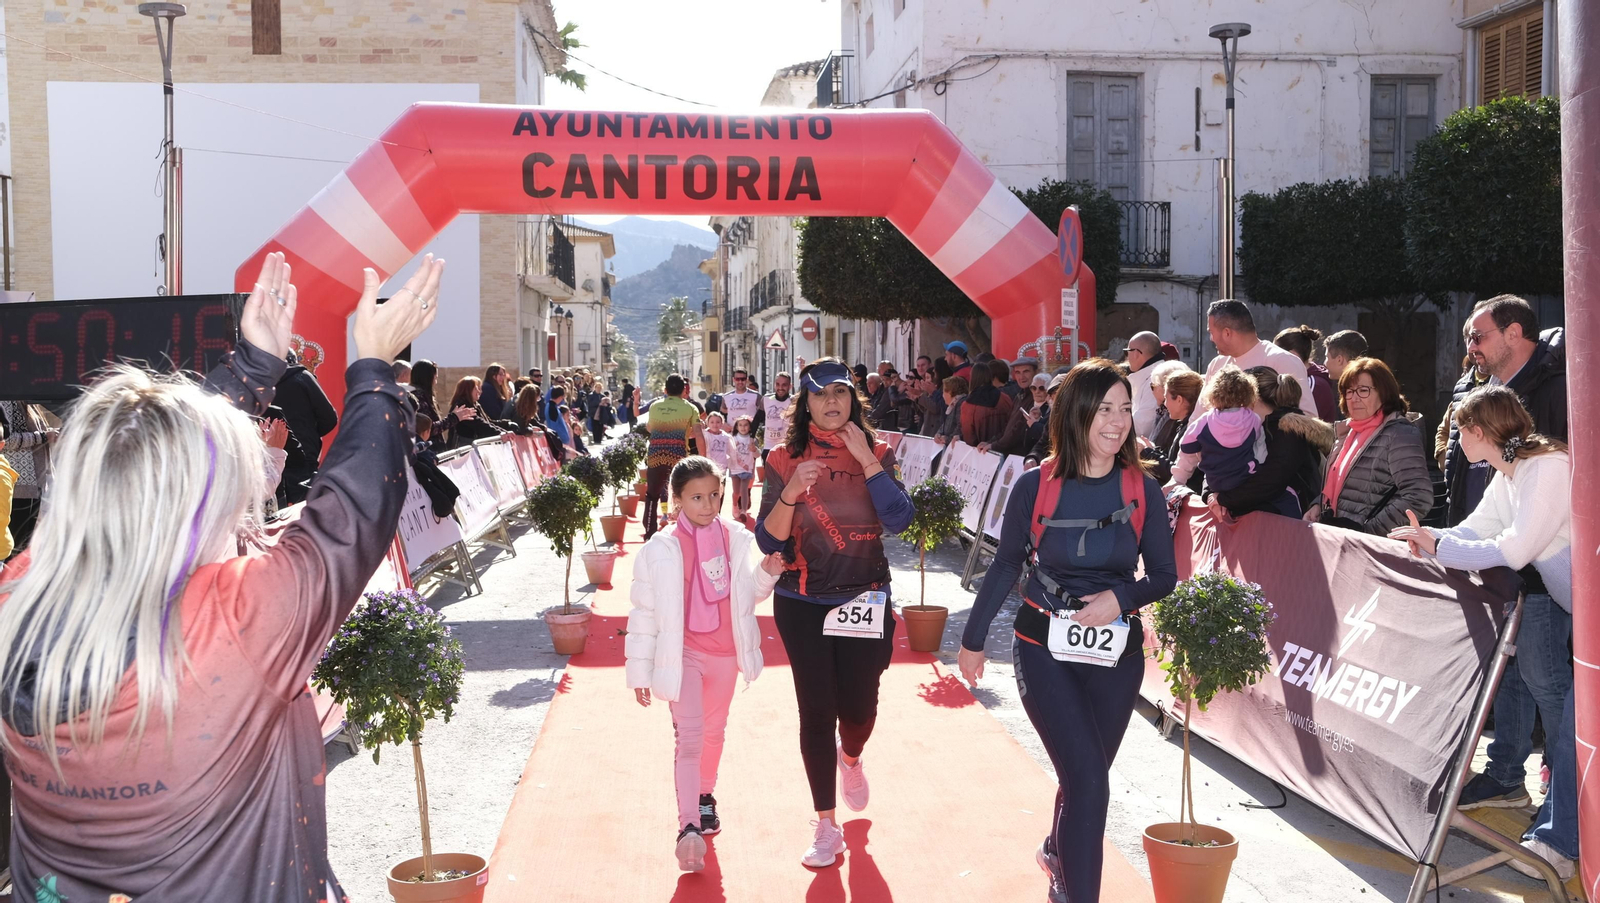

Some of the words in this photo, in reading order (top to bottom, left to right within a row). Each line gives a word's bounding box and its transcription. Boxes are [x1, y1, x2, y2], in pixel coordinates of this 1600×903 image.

[511, 111, 834, 141] AYUNTAMIENTO
[521, 151, 823, 201] CANTORIA
[836, 605, 874, 625] 554
[1066, 624, 1114, 652] 602
[1273, 641, 1422, 724] TEAMERGY
[20, 769, 39, 788] DE
[46, 779, 169, 800] ALMANZORA
